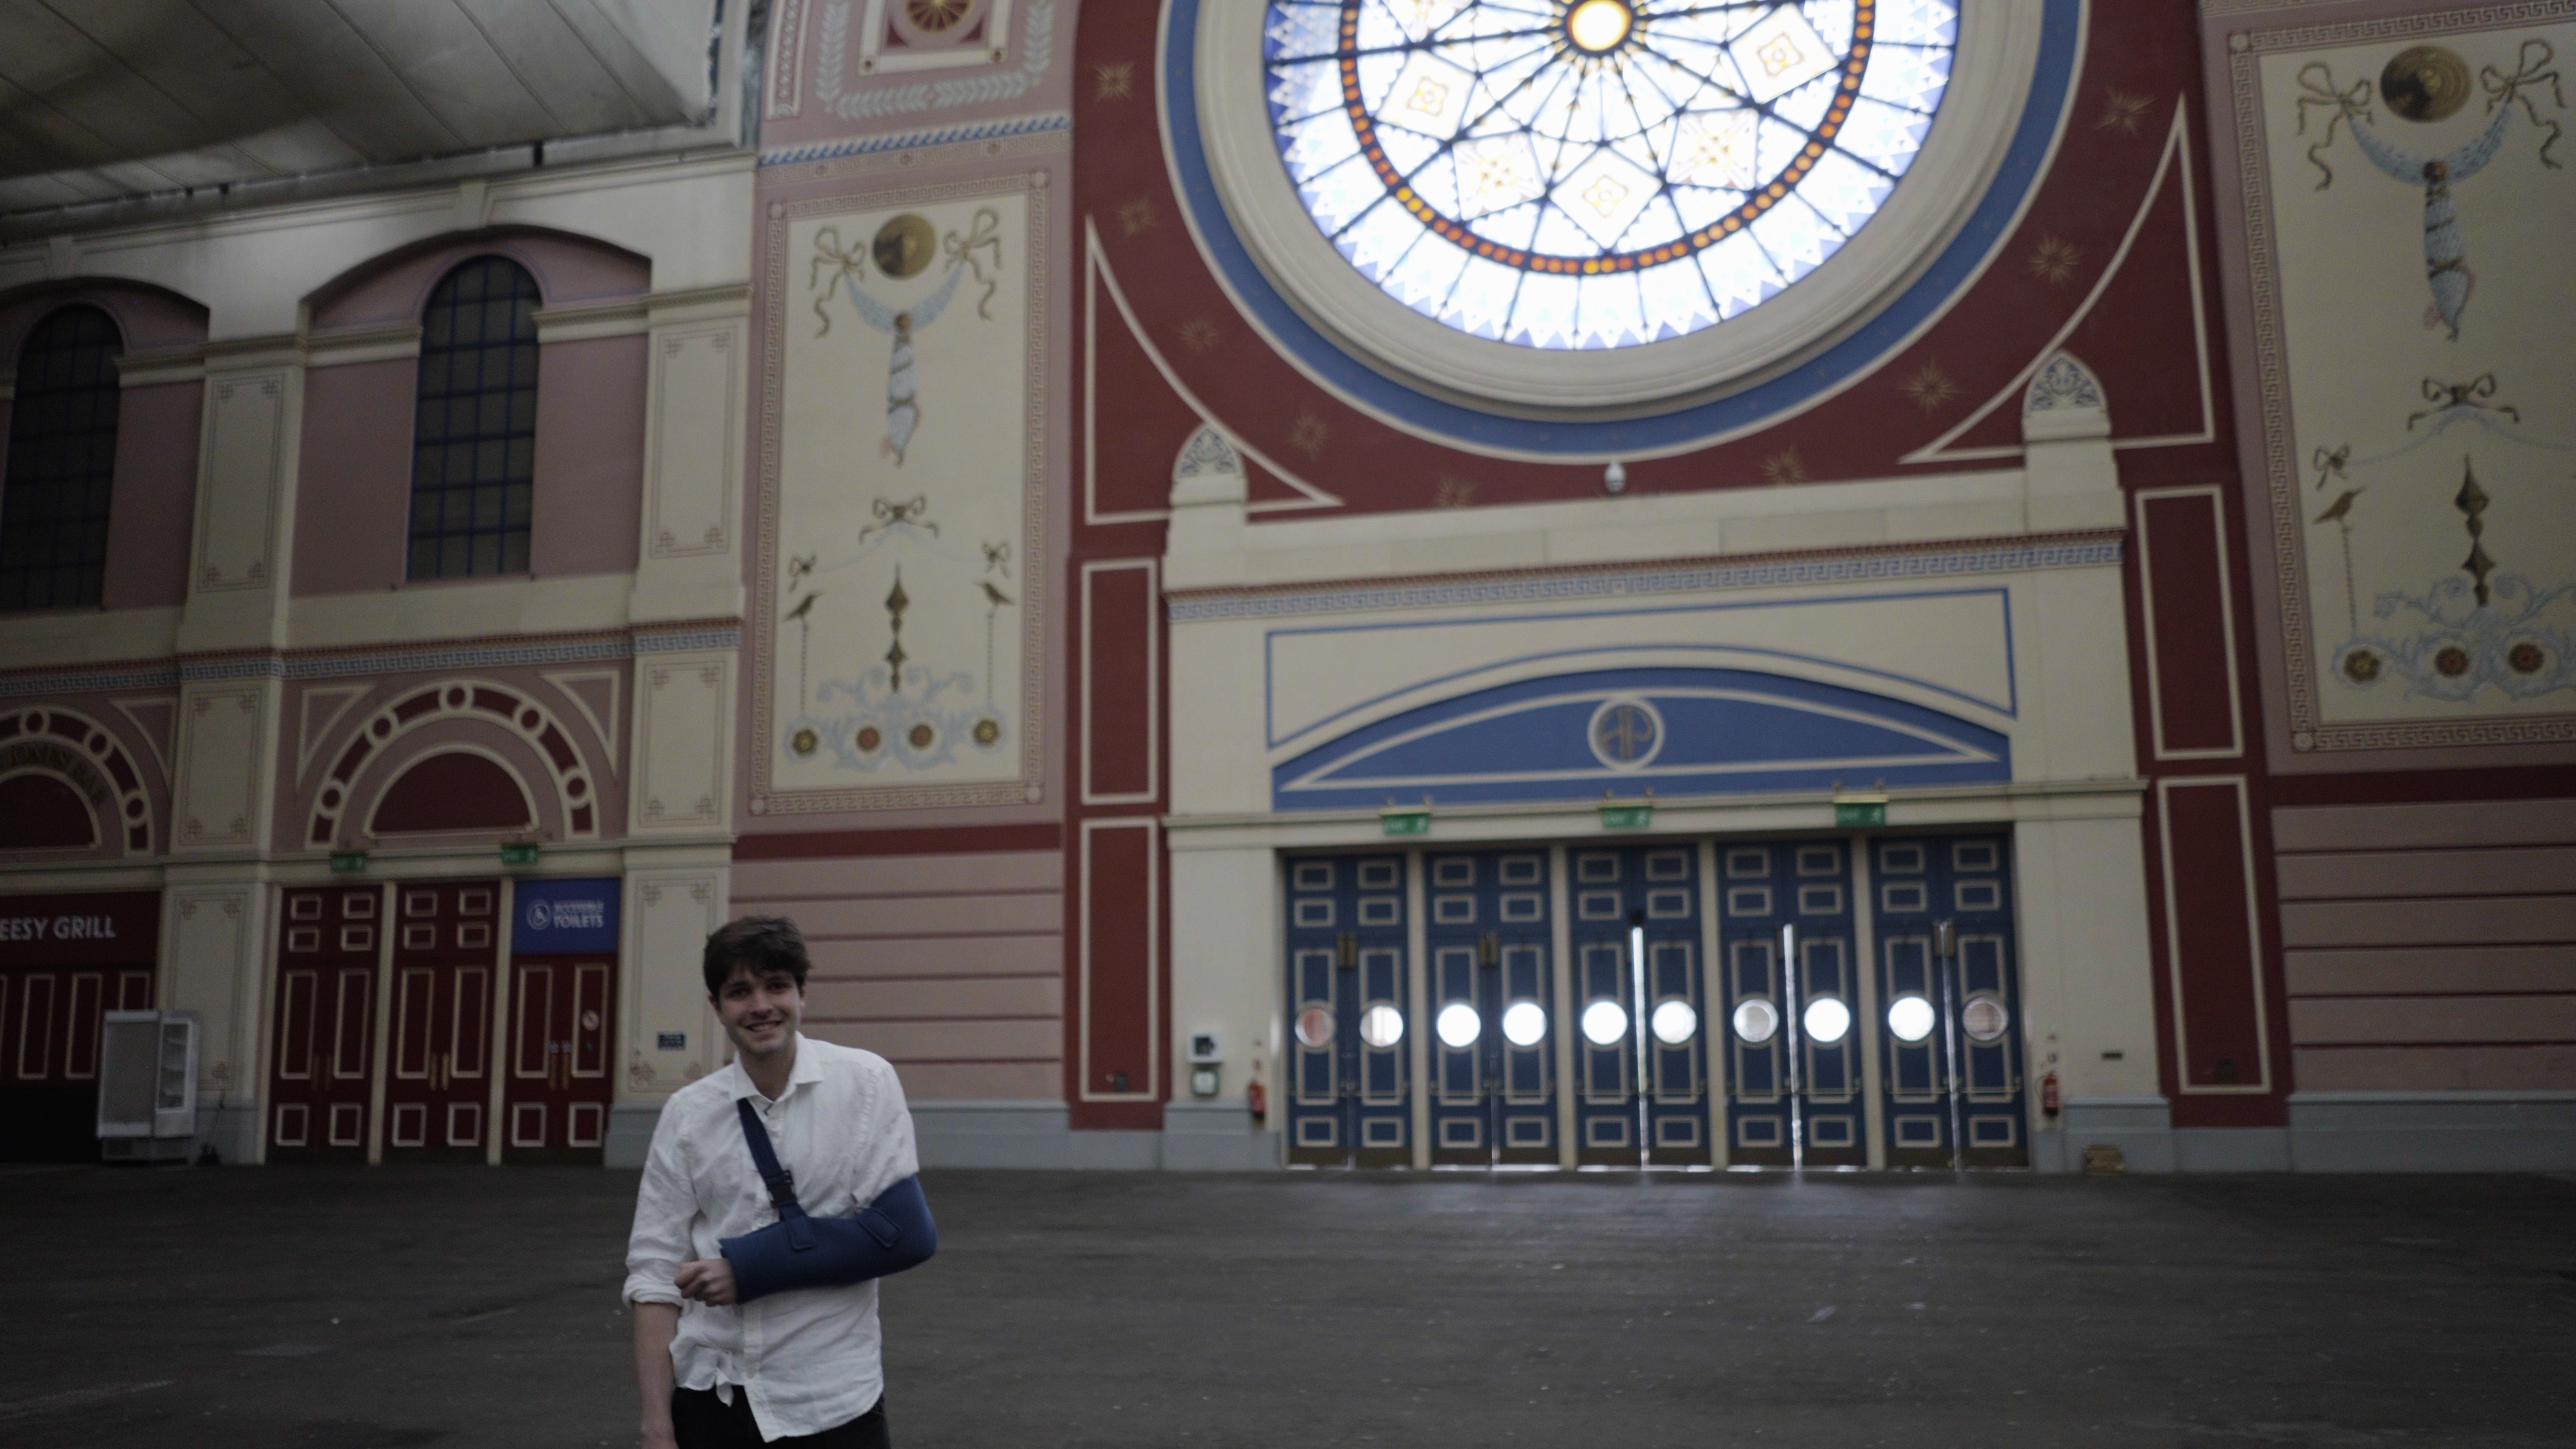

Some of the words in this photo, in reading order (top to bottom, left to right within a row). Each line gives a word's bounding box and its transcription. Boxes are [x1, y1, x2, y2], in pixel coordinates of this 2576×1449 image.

[0, 917, 50, 941] EESY
[53, 915, 117, 940] GRILL
[553, 914, 604, 929] TOILETS
